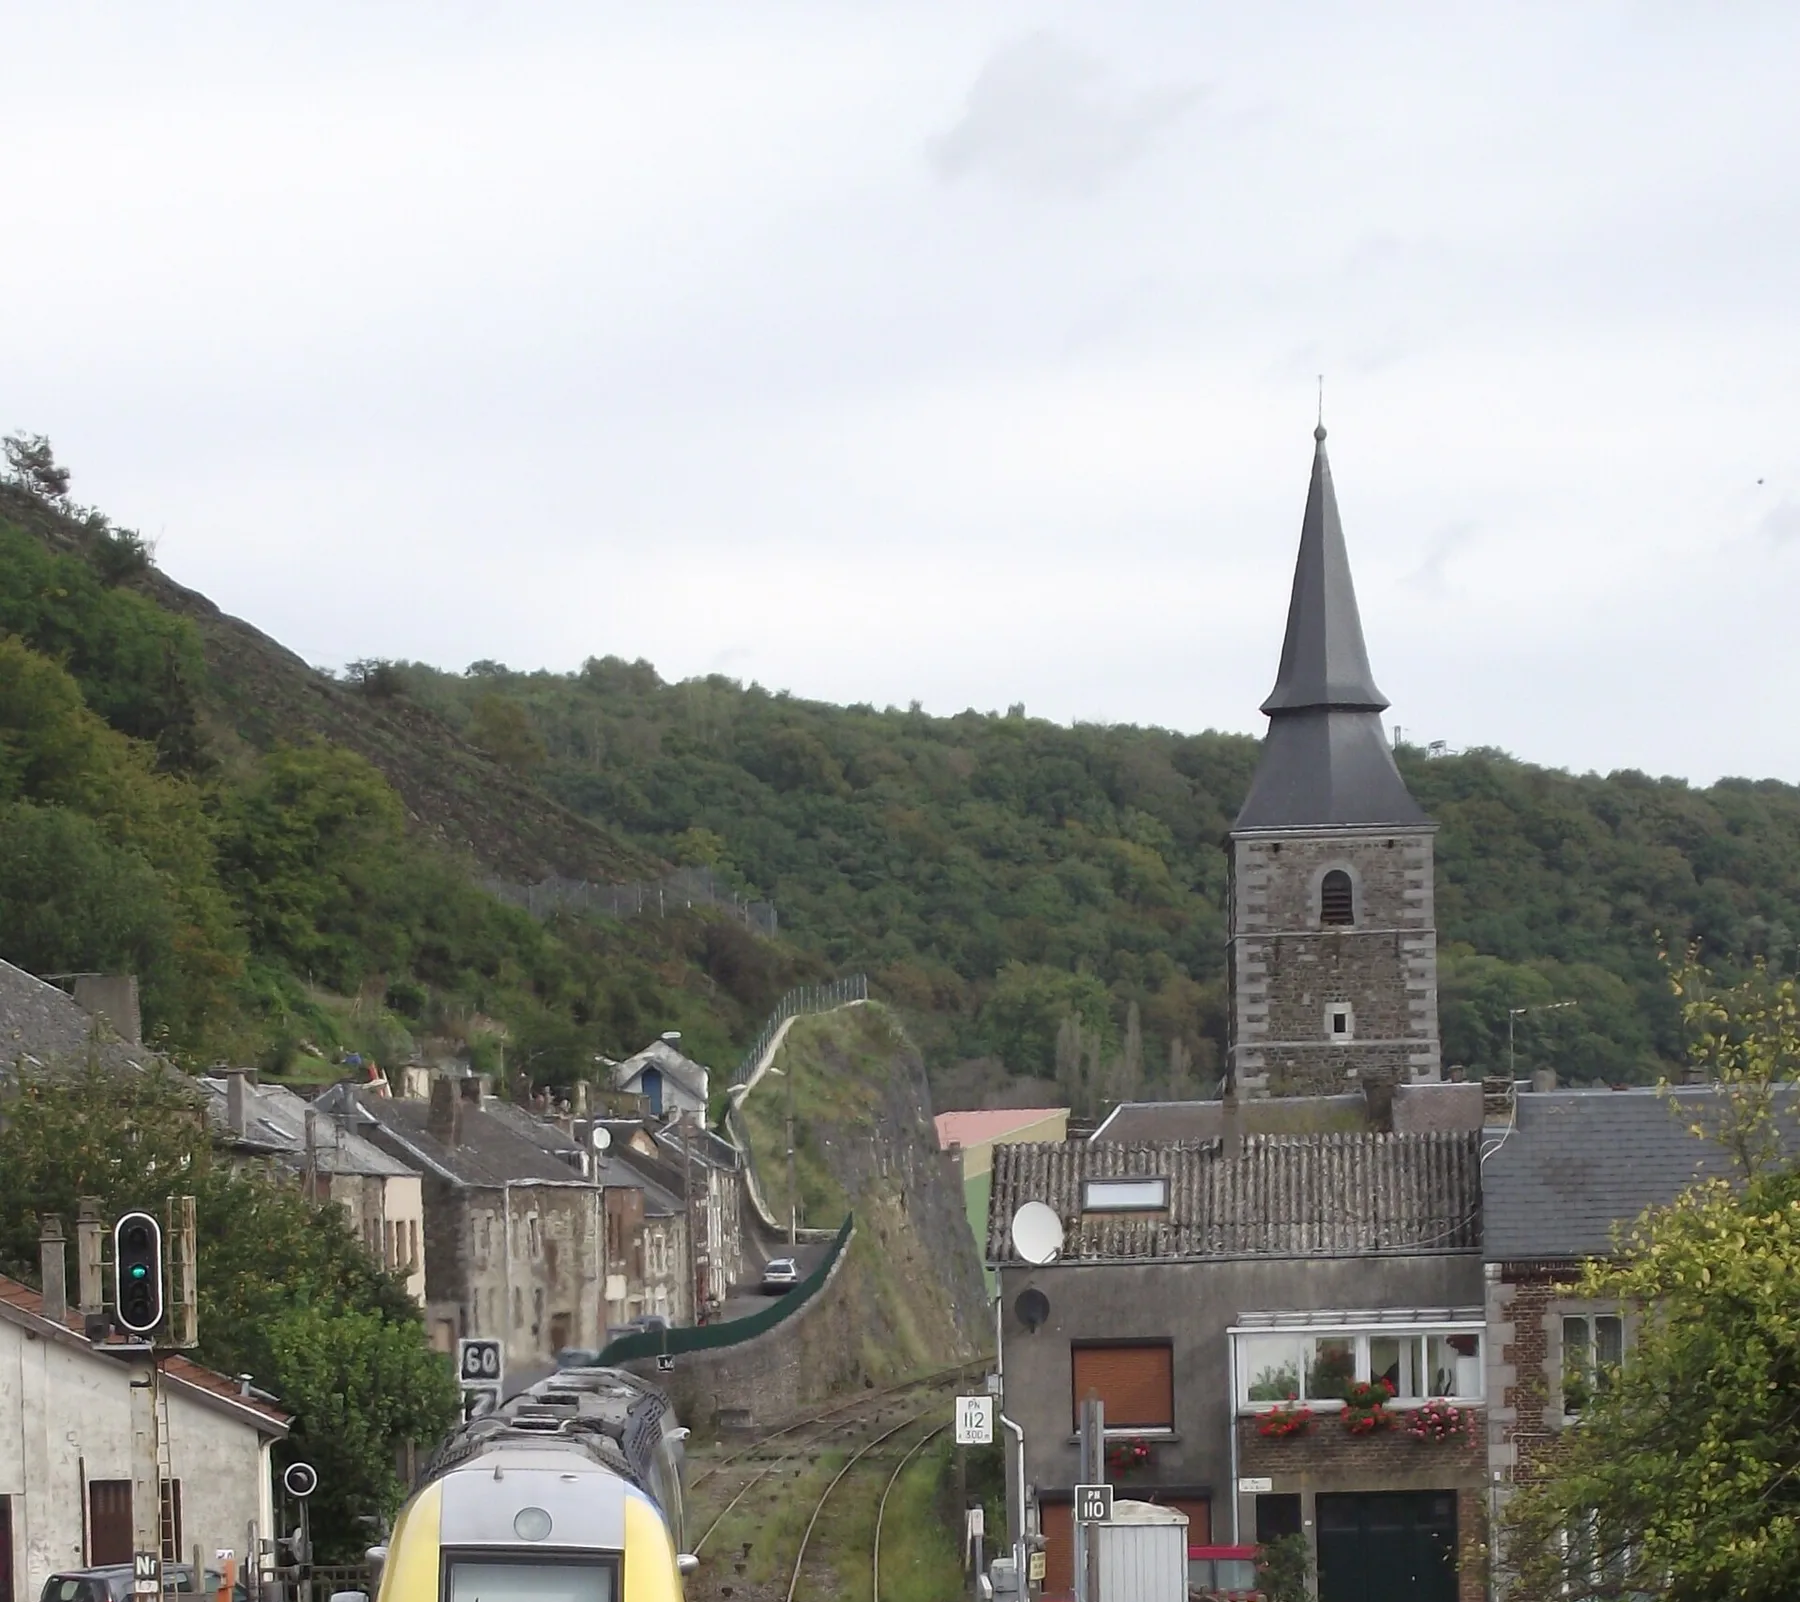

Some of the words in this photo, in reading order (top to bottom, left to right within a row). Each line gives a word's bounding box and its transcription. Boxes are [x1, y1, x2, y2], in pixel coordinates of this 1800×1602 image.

[466, 1347, 497, 1373] 60
[967, 1400, 981, 1409] PN
[964, 1412, 985, 1428] 112
[966, 1430, 984, 1439] 300
[1087, 1490, 1101, 1500] PN
[1084, 1501, 1105, 1518] 110
